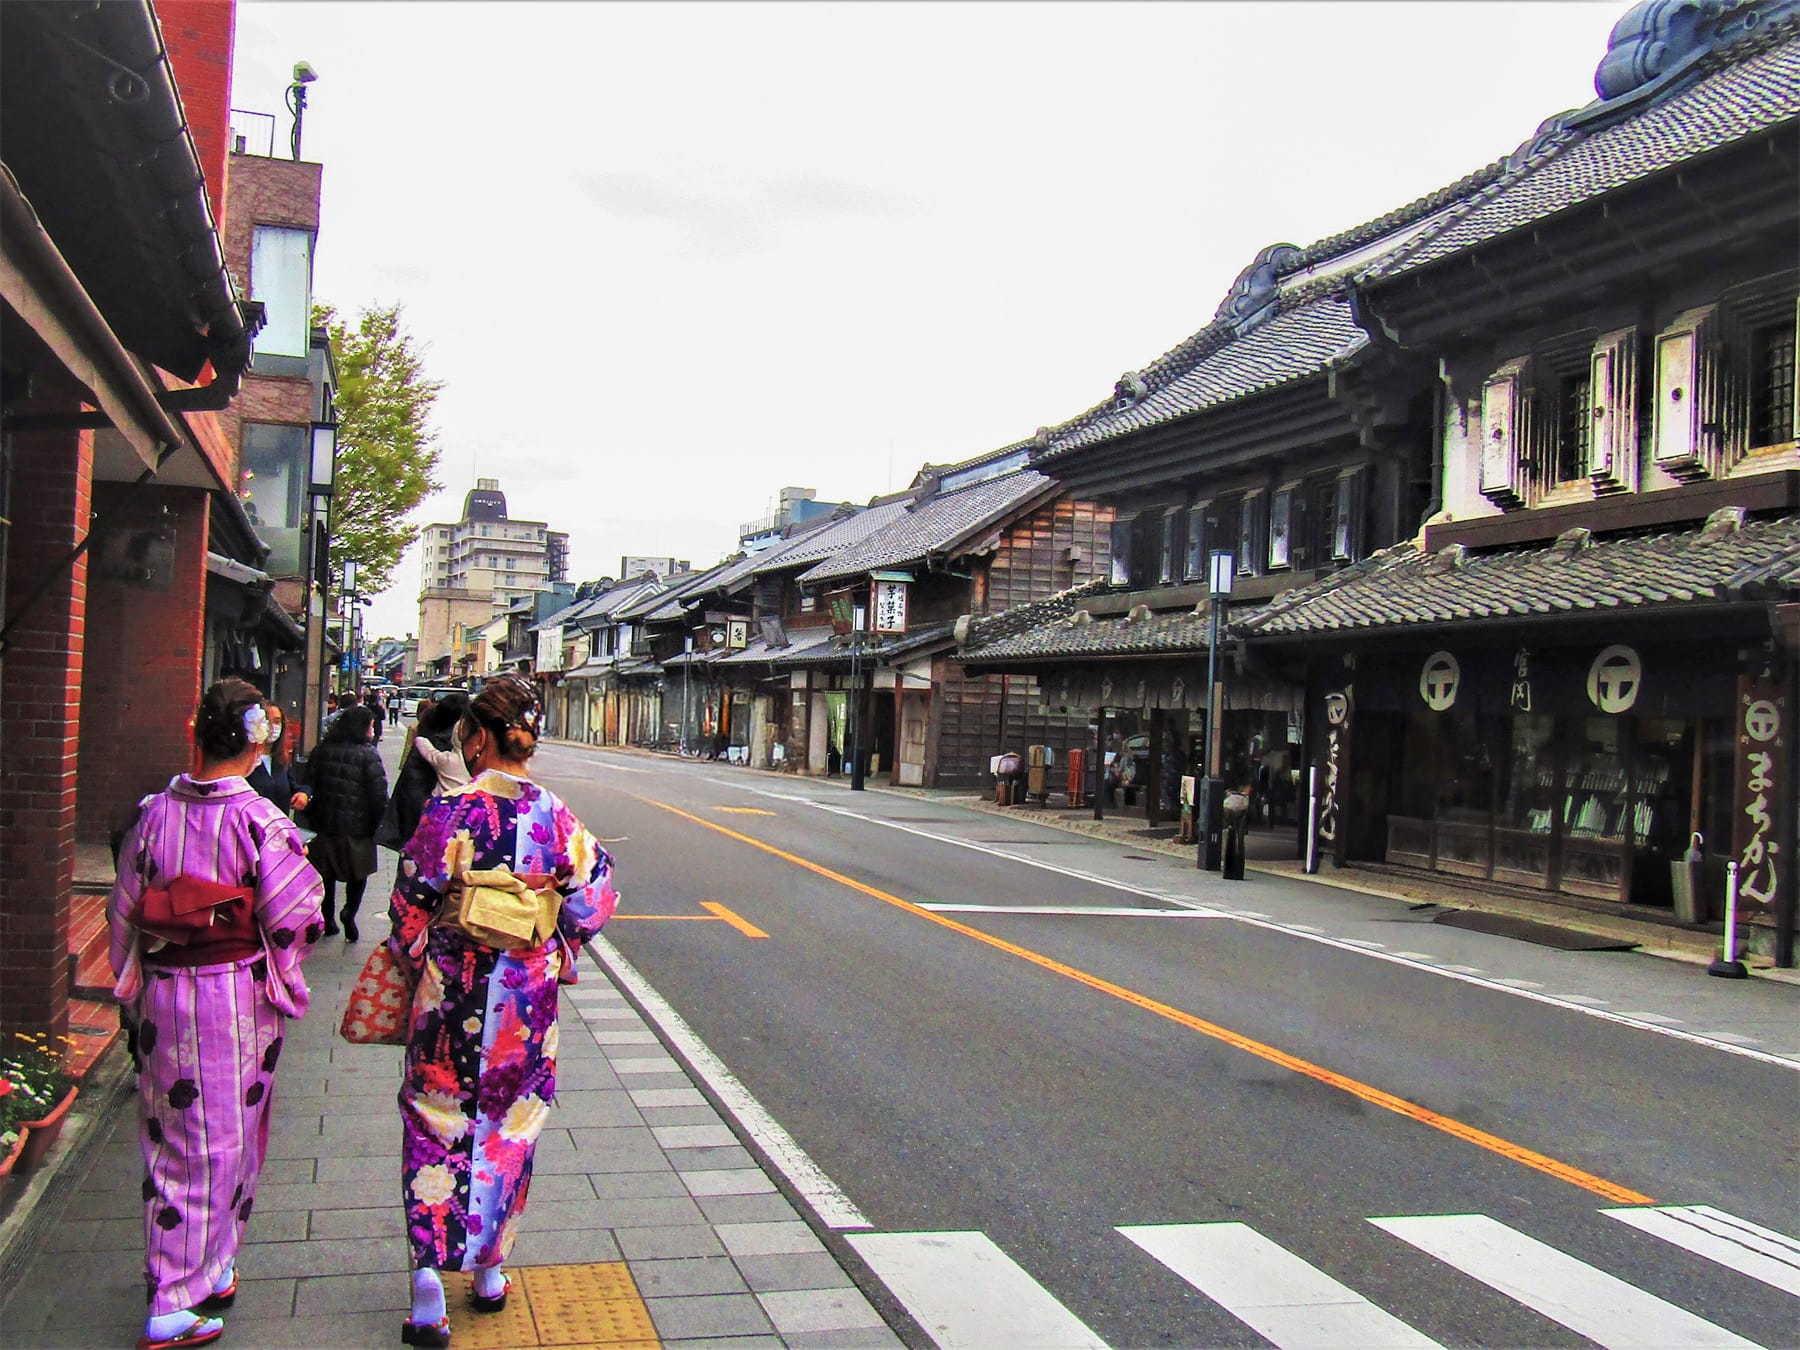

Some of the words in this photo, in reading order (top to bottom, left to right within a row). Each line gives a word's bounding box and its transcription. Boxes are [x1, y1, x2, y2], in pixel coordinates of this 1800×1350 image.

[887, 584, 896, 629] 芋菓子
[1739, 752, 1780, 903] まちかん
